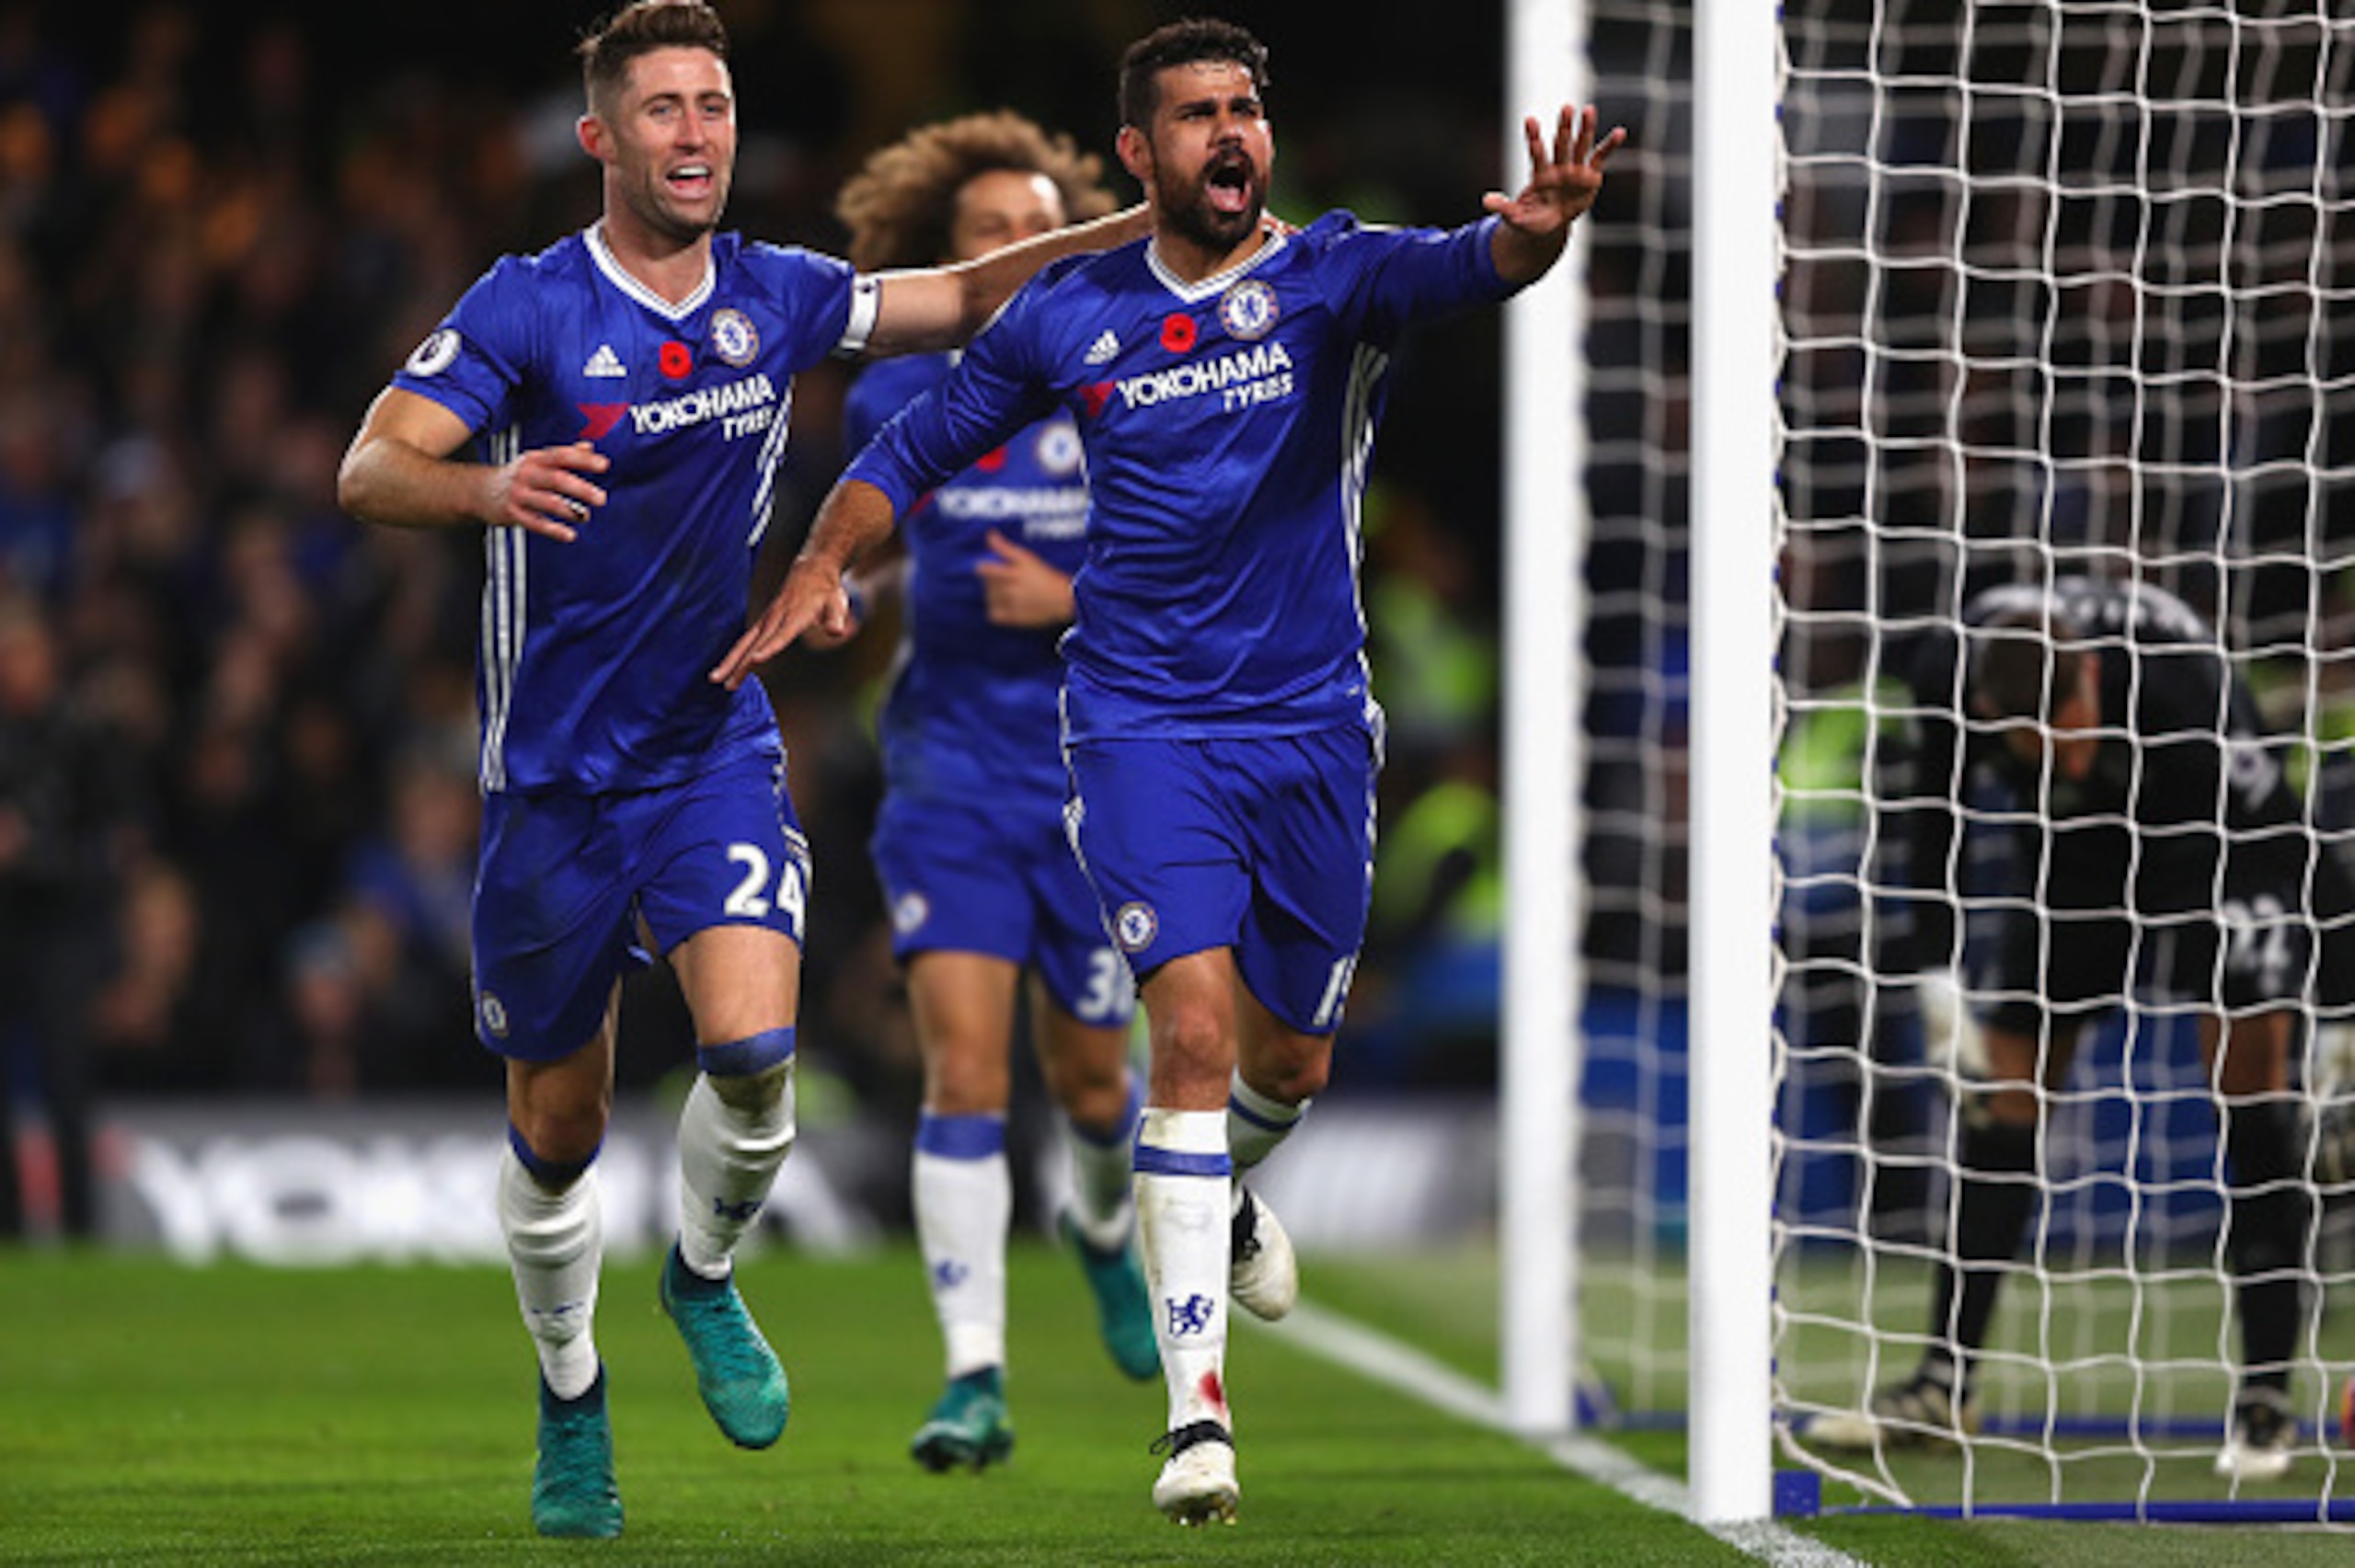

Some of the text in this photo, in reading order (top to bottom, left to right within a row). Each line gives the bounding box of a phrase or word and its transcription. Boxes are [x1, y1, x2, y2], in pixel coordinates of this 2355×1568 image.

[629, 372, 776, 434] YOKOHAMA
[1116, 341, 1292, 408] YOKOHAMA
[1222, 372, 1293, 413] TYRES
[724, 842, 805, 940] 24
